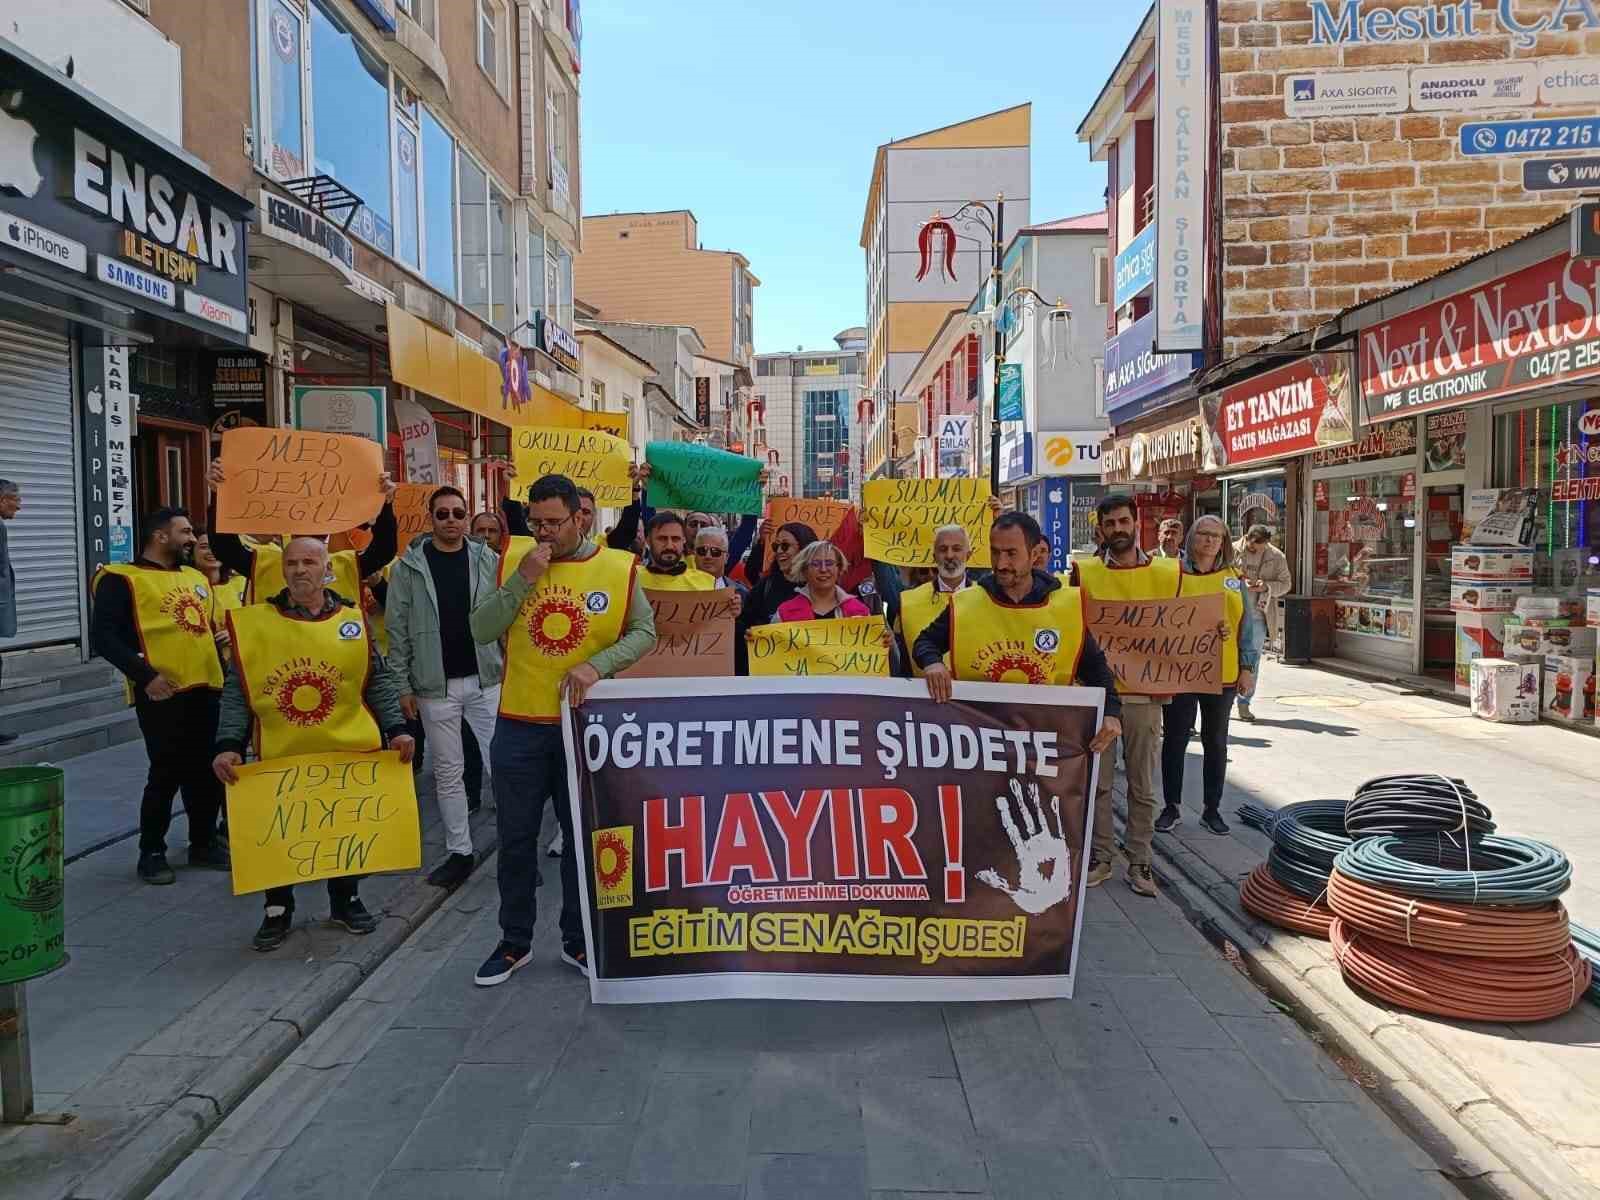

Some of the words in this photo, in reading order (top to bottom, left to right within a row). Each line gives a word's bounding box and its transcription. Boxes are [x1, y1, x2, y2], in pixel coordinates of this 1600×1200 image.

[1310, 0, 1480, 44] Mesut
[1174, 10, 1192, 86] MESUT
[1420, 78, 1486, 90] ANADOLU
[1505, 127, 1551, 149] 0472
[1556, 125, 1593, 145] 215
[74, 127, 238, 276] ENSAR
[23, 225, 70, 260] iPhone
[106, 263, 169, 300] SAMSUNG
[1529, 354, 1570, 379] 0472
[1225, 401, 1246, 431] ET
[1248, 376, 1314, 425] TANZİM
[1408, 369, 1488, 406] ELEKTRONİK
[940, 438, 970, 449] EMLAK
[942, 420, 968, 436] AY
[1231, 434, 1257, 452] SATIŞ
[1258, 416, 1312, 449] MAĞAZASI
[256, 433, 343, 469] MEB
[584, 712, 863, 772] ÖĞRETMENE
[875, 711, 1059, 780] ŞİDDETE
[287, 832, 379, 878] MEB
[643, 786, 928, 893] HAYIR
[937, 784, 966, 903] !
[727, 880, 849, 904] ÖĞRETMENİME
[850, 882, 929, 902] DOKUNMA
[632, 909, 744, 952] EĞİTİM
[753, 915, 828, 947] SEN
[832, 909, 913, 950] AĞRI
[922, 914, 1025, 961] ŞUBESİ
